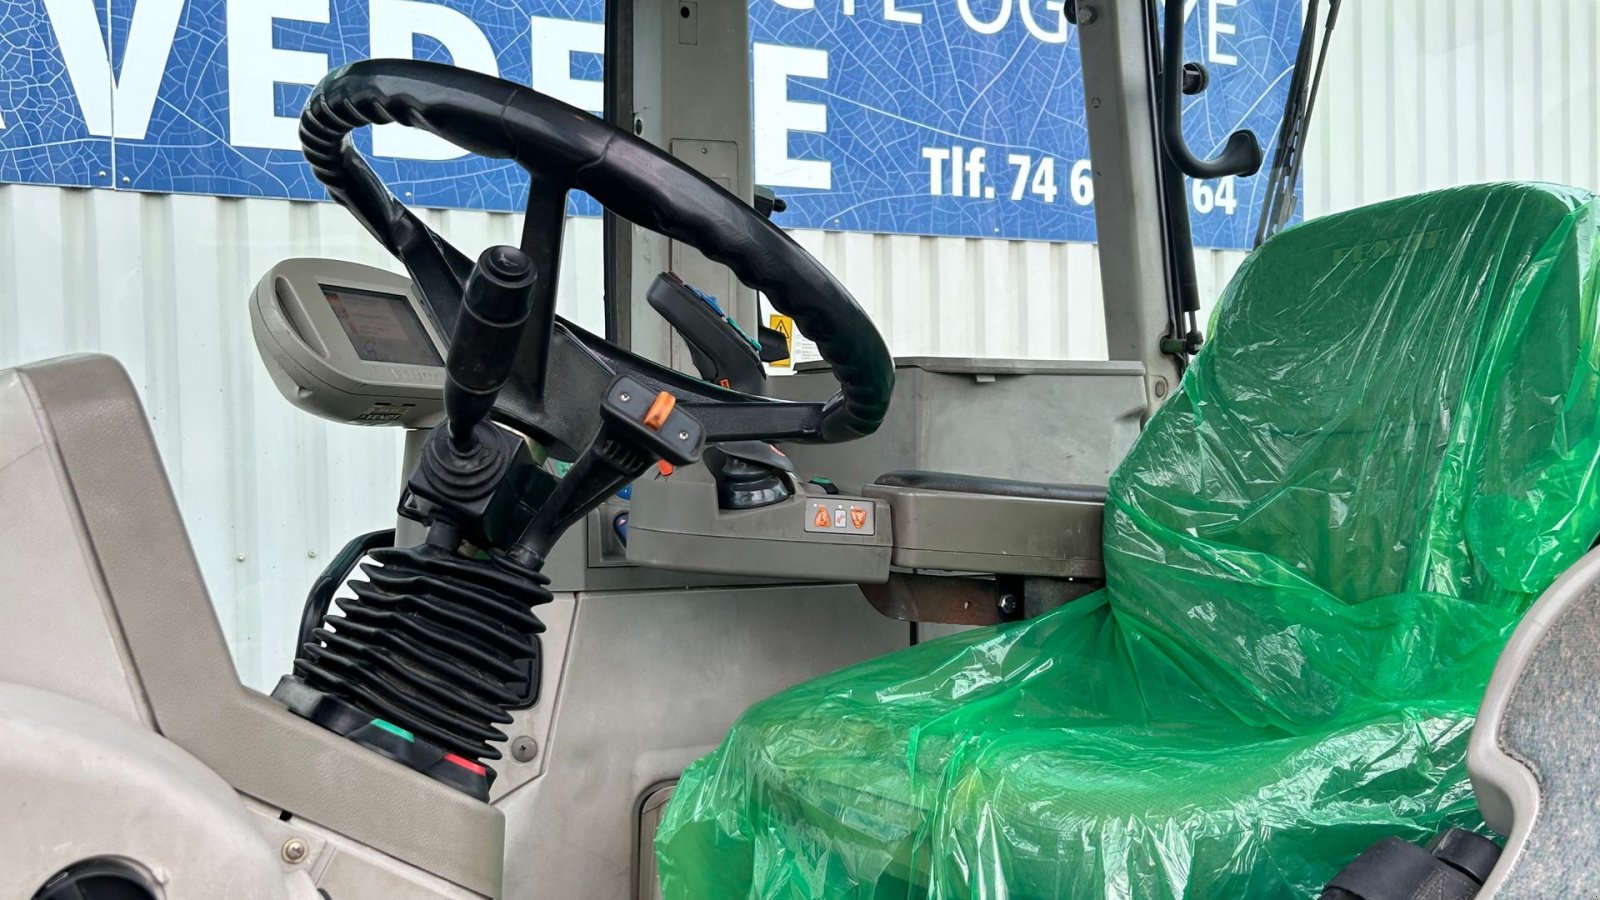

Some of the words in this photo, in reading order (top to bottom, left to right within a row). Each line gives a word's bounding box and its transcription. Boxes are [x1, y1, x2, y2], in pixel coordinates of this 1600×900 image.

[922, 146, 995, 199] Tlf.
[1008, 154, 1057, 203] 74
[1070, 159, 1094, 206] 6
[1192, 175, 1237, 215] 64
